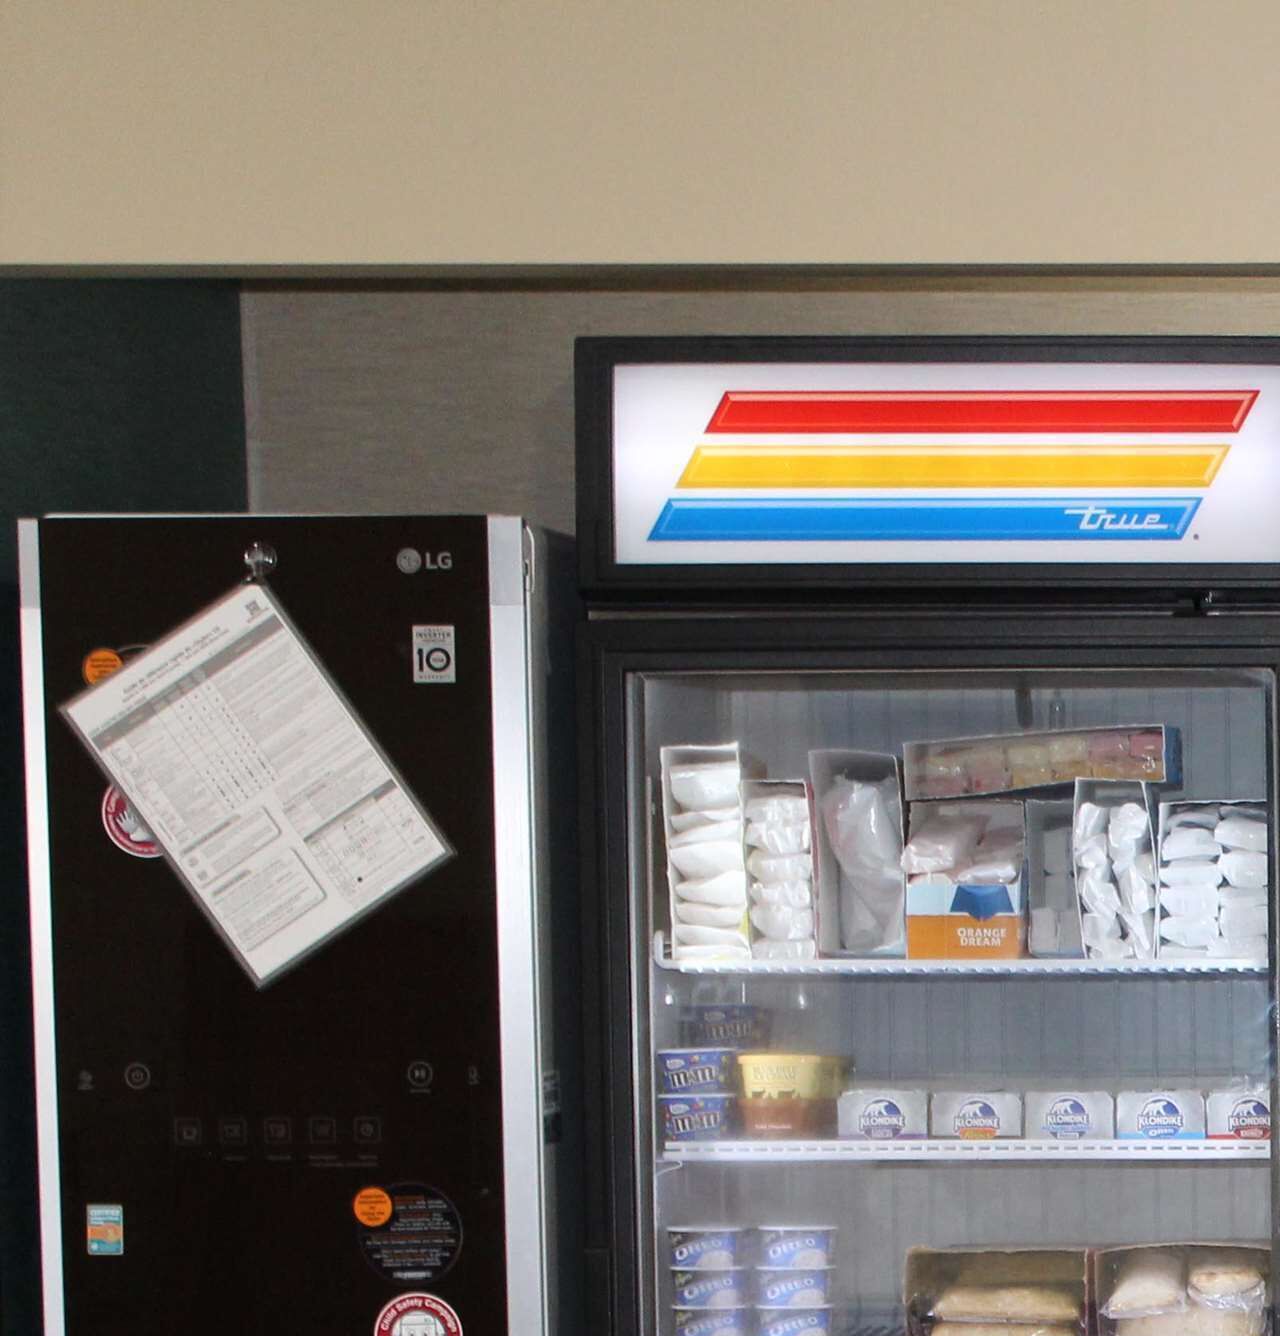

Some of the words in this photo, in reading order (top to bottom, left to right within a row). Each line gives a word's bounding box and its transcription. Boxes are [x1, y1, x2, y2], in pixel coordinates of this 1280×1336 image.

[426, 552, 452, 569] LG
[957, 928, 1007, 938] ORANGE
[959, 937, 1002, 947] DREAM
[954, 1116, 1000, 1130] KLONDIKE
[1047, 1115, 1089, 1125] KLONDIKE
[1138, 1116, 1183, 1130] KLONDIKE
